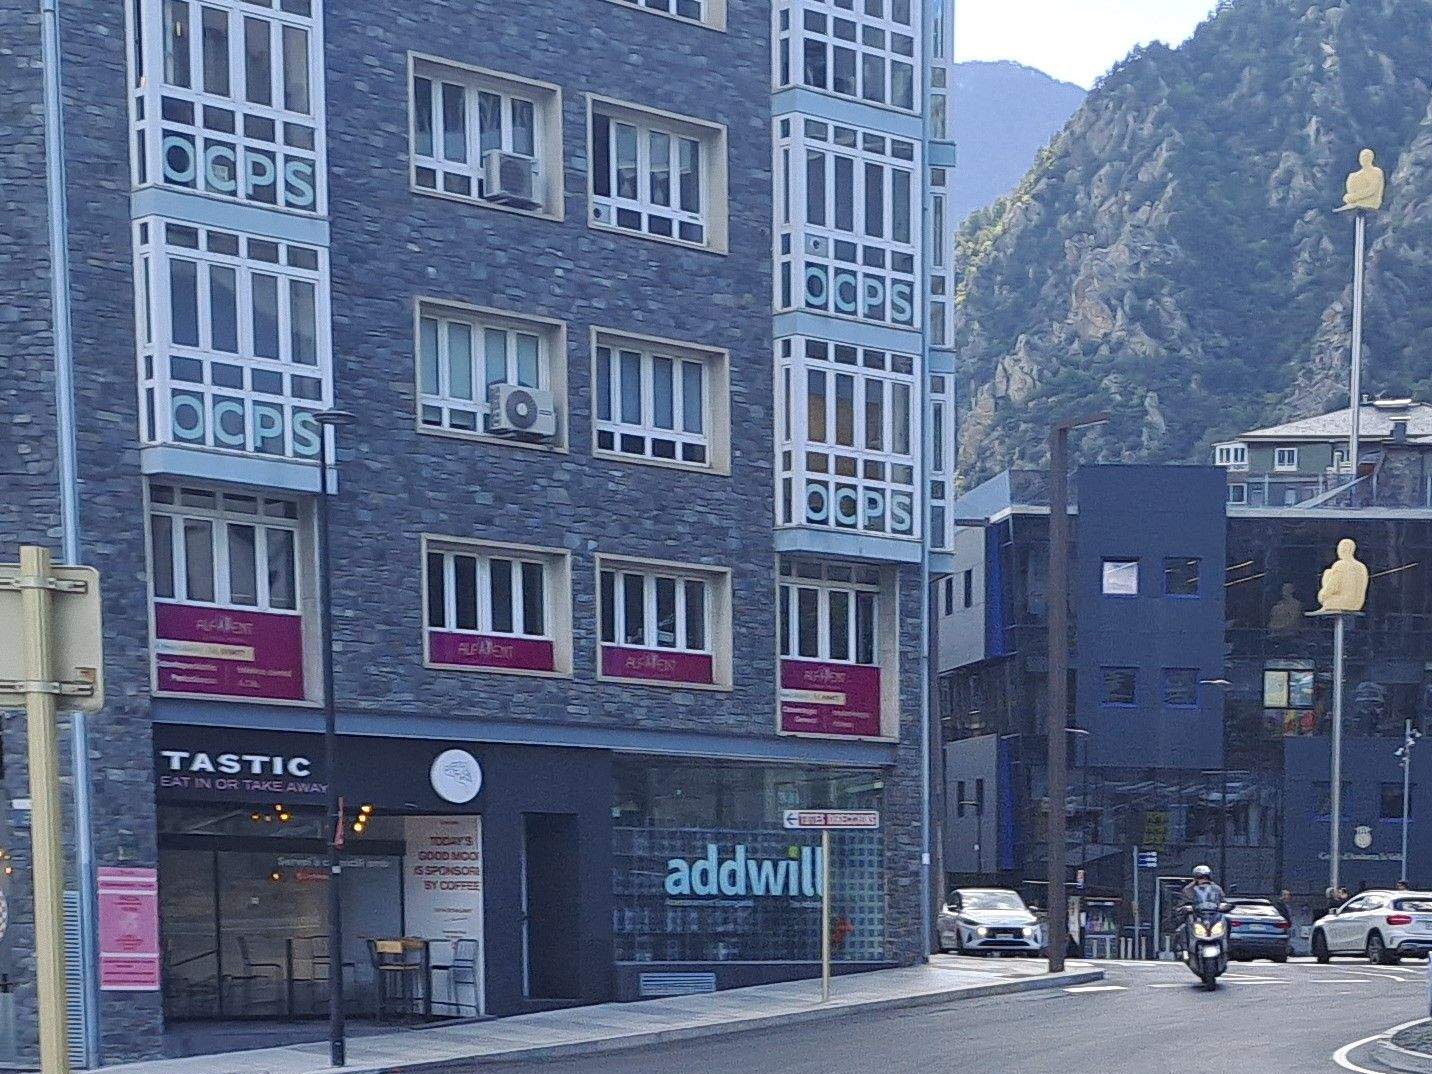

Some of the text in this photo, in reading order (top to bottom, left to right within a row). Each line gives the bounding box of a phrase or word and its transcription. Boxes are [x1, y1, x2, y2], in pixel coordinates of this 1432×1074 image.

[163, 135, 315, 206] OCPS
[805, 266, 912, 322] OCPS
[172, 394, 322, 456] OCPS
[806, 483, 911, 531] OCPS
[160, 775, 329, 794] EAT IN OR TAKE AWAY
[161, 750, 312, 777] TASTIC
[424, 880, 437, 891] BY
[663, 843, 825, 897] addwill
